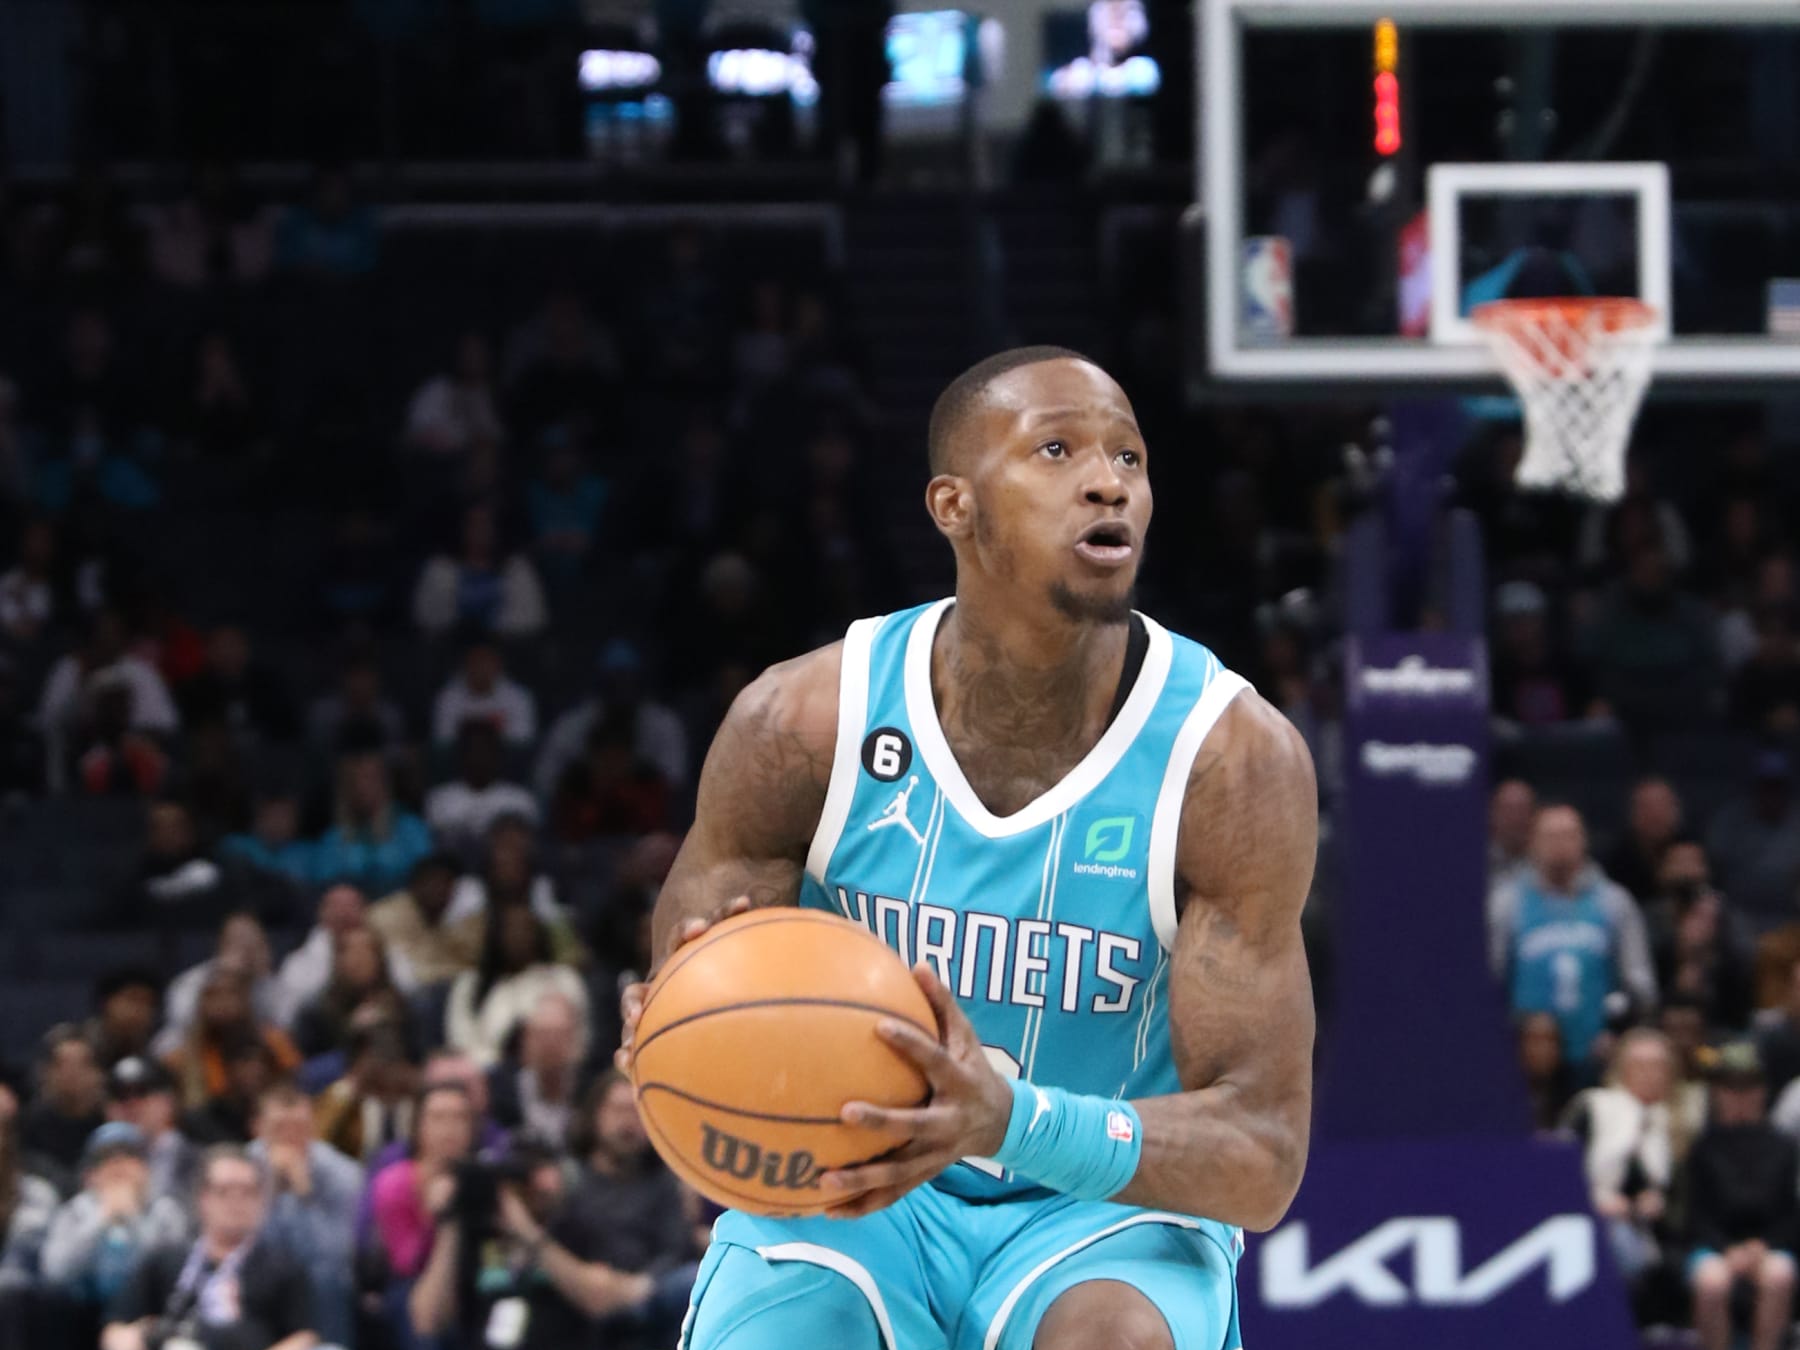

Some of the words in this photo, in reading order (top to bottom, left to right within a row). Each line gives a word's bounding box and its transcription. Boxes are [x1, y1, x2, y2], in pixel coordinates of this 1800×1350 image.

[873, 734, 903, 776] 6
[1073, 861, 1137, 879] lendingtree
[701, 1120, 824, 1191] Wil
[1261, 1214, 1597, 1308] KIA
